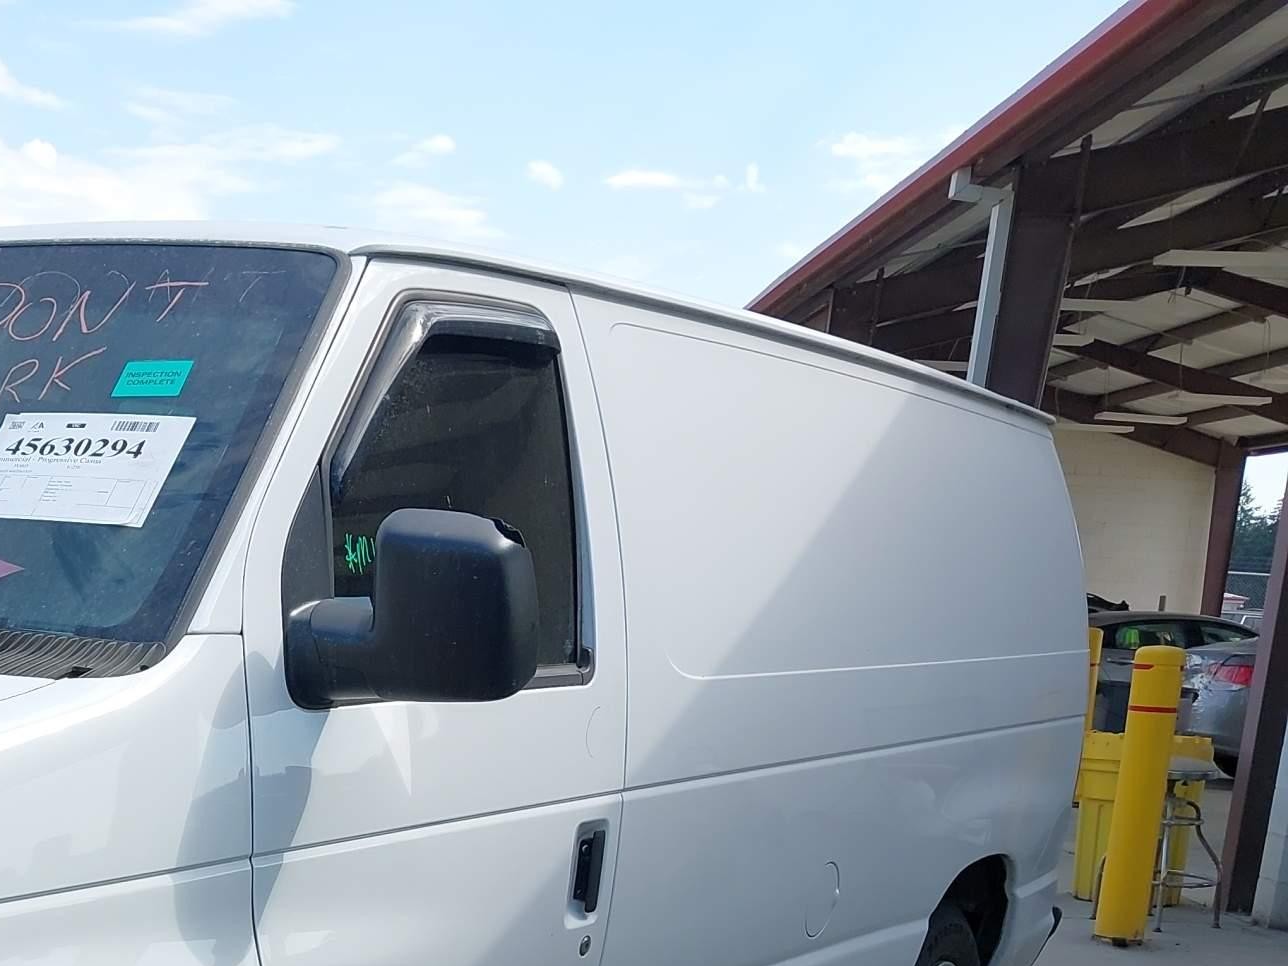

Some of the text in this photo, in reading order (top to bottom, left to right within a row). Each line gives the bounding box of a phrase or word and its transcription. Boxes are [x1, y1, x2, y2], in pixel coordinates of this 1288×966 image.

[125, 370, 182, 378] INSPECTION
[126, 378, 176, 386] COMPLETE
[5, 437, 147, 459] 45630294
